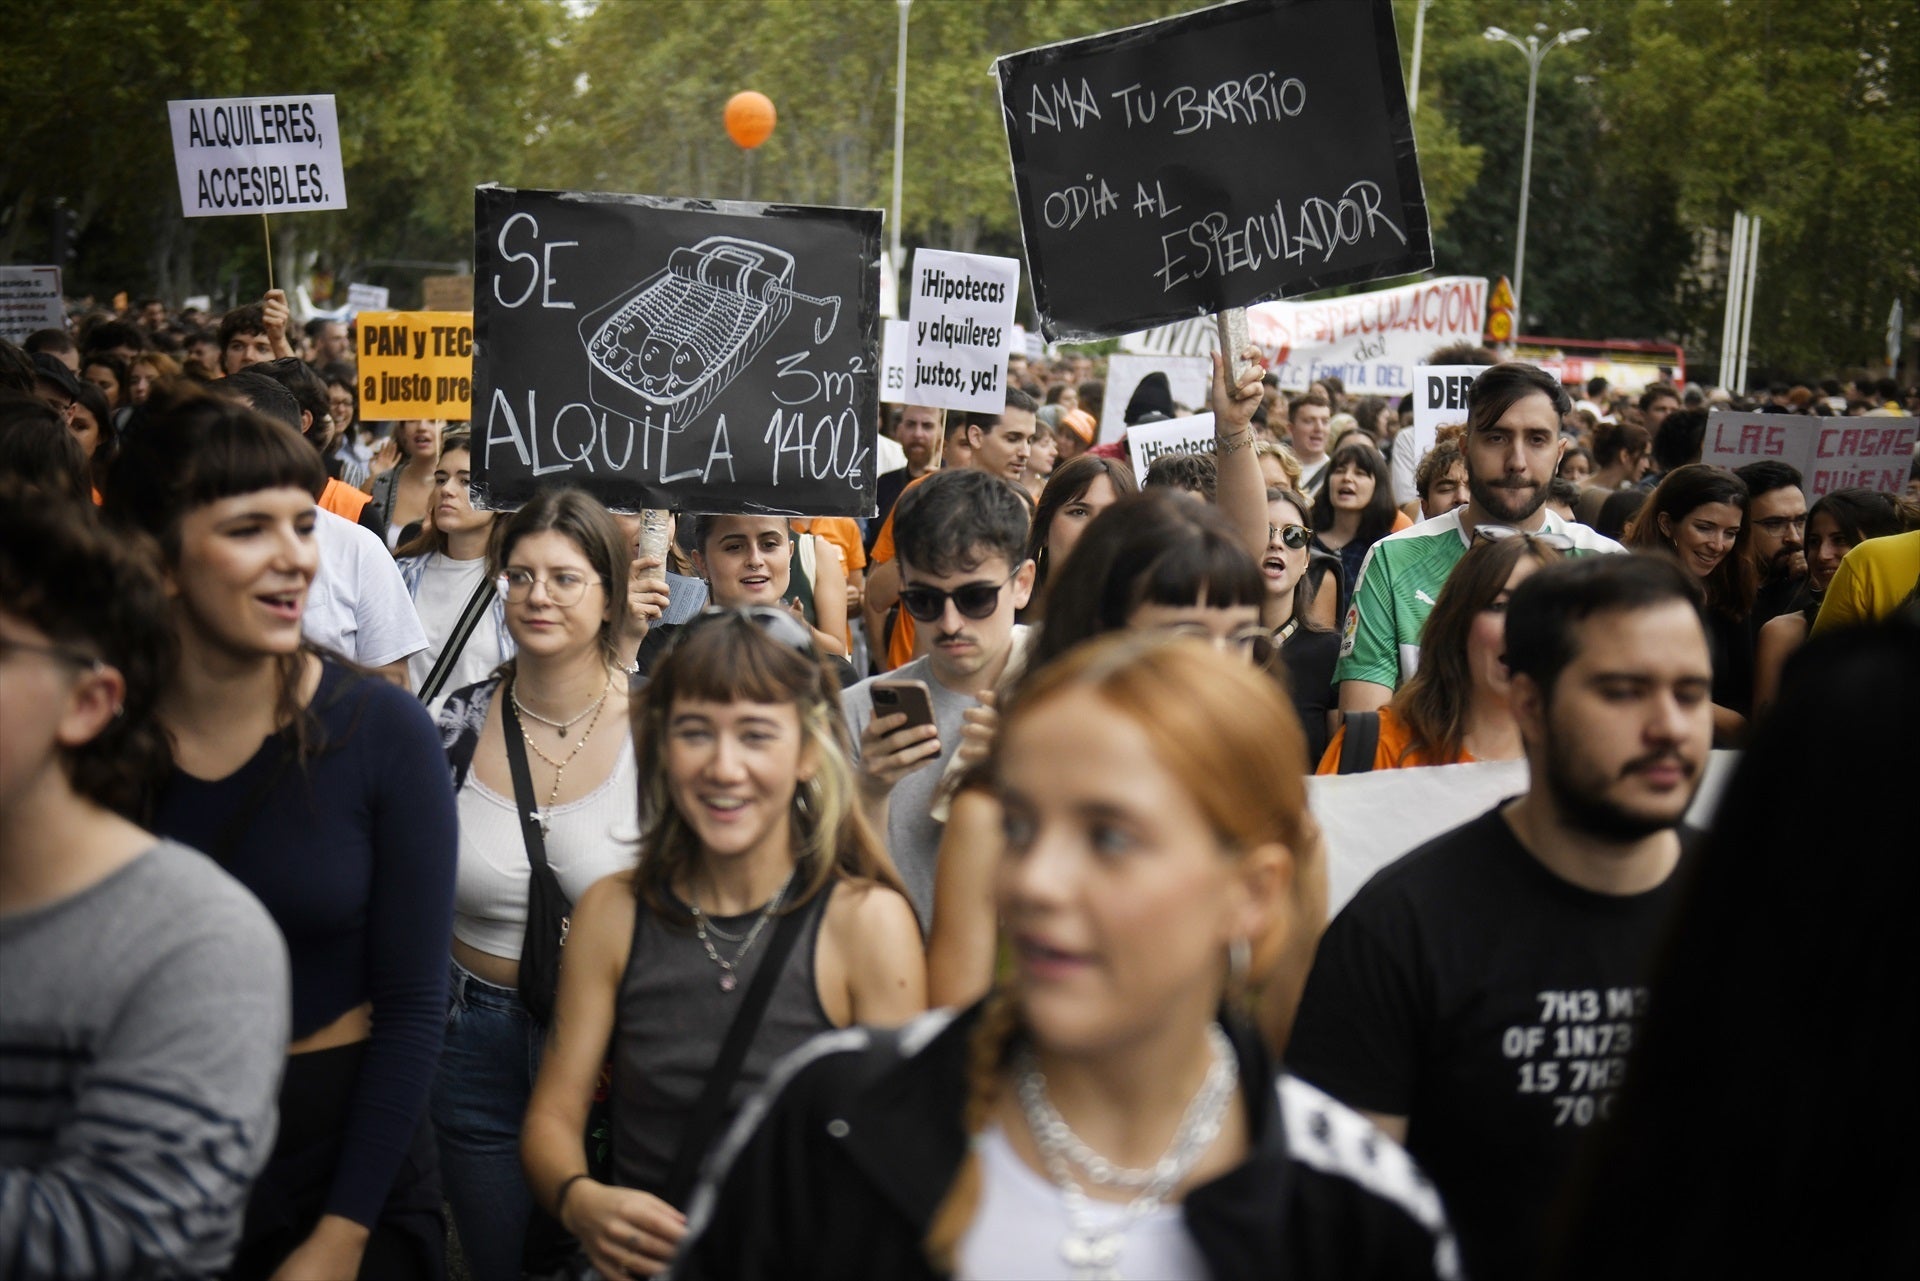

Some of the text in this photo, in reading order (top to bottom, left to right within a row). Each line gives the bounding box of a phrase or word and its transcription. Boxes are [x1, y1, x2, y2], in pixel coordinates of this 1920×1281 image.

[1027, 77, 1101, 134] AMA
[1112, 83, 1156, 128] TU
[189, 102, 323, 149] ALQUILERES,
[198, 163, 329, 209] ACCESIBLES.
[1133, 180, 1182, 218] AL
[1153, 180, 1407, 293] ESPECULADOR
[493, 212, 579, 309] SE
[921, 268, 1005, 304] ¡Hipotecas
[363, 325, 474, 360] PAN y TEC
[917, 315, 1002, 349] y alquileres
[363, 371, 471, 405] a justo pre
[914, 357, 998, 396] justos, ya!
[1376, 364, 1406, 387] DEL
[1714, 423, 1915, 459] LAS CASAS
[1536, 989, 1601, 1023] 7H3
